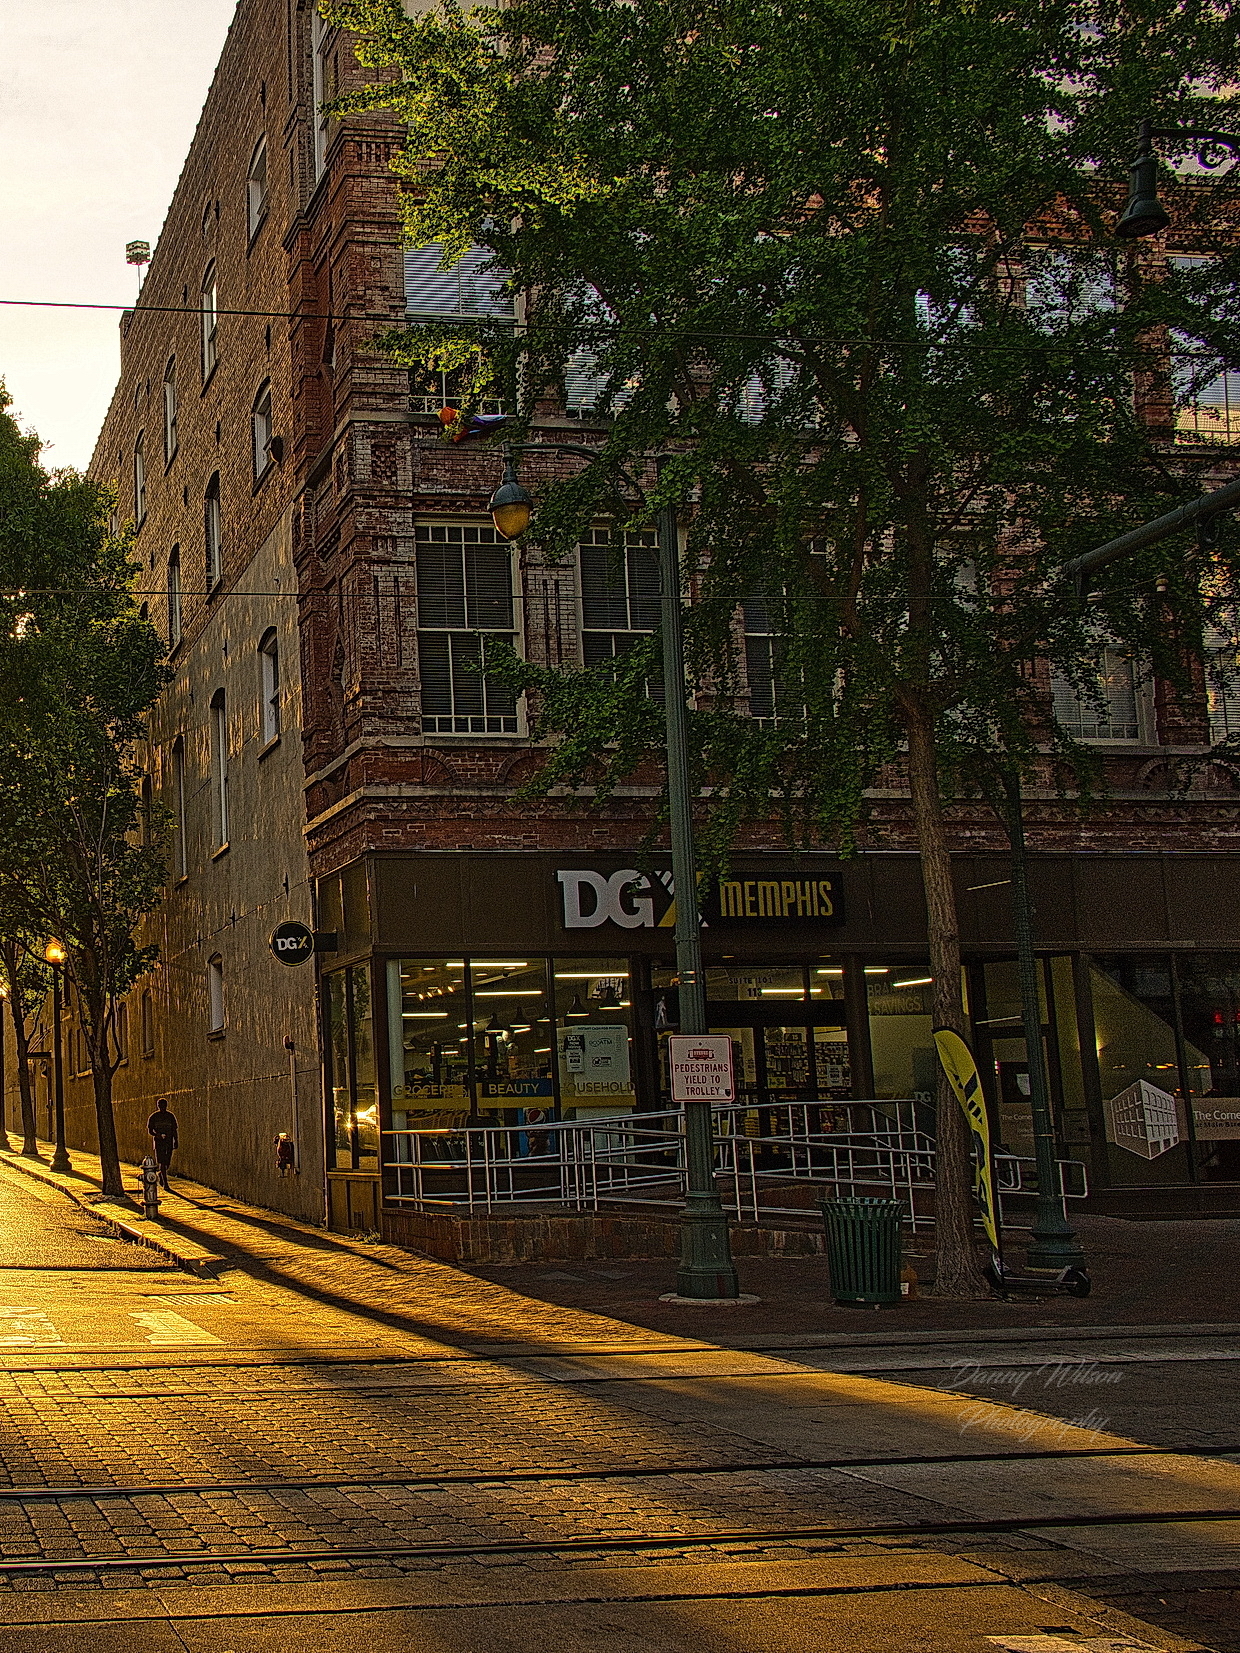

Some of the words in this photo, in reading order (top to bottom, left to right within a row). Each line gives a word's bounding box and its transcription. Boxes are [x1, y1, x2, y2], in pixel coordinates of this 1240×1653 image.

[720, 880, 834, 917] MEMPHIS
[276, 936, 310, 951] DGX
[729, 977, 753, 985] SUITE
[757, 977, 773, 985] 101
[674, 1063, 729, 1073] PEDESTRIANS
[684, 1075, 707, 1085] YIELD
[710, 1075, 721, 1084] TO
[488, 1083, 540, 1095] BEAUTY
[685, 1087, 720, 1096] TROLLEY
[1193, 1110, 1212, 1120] The
